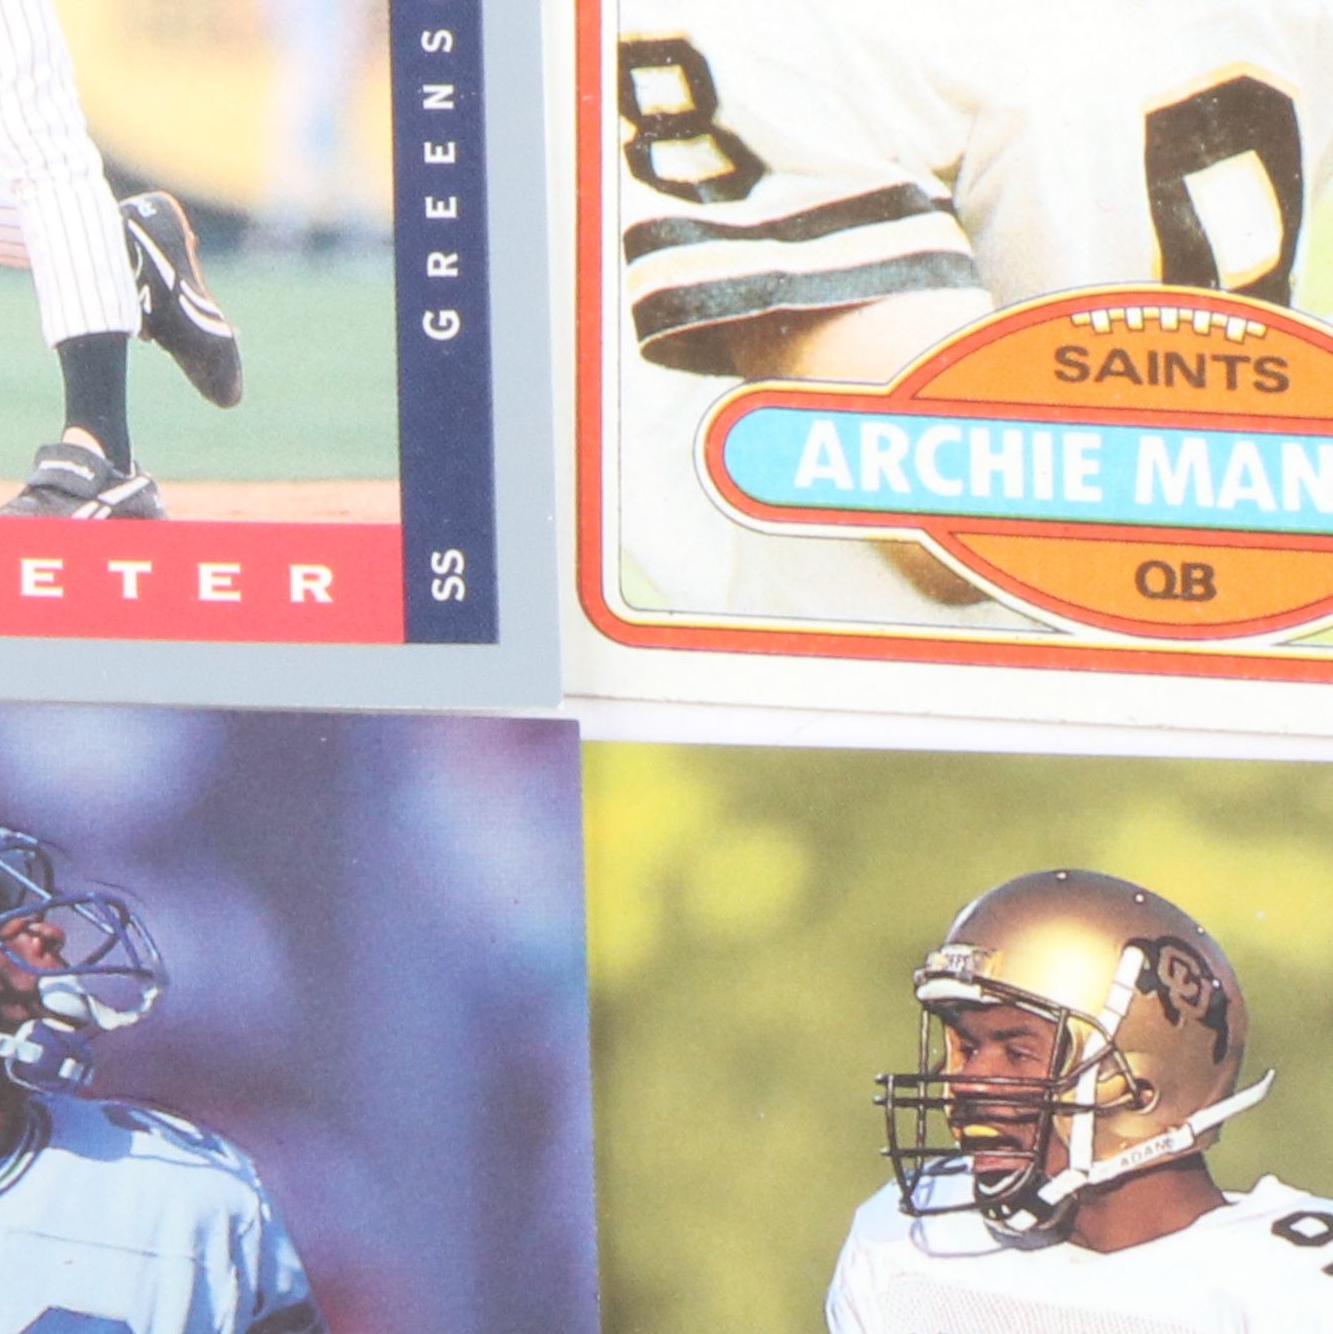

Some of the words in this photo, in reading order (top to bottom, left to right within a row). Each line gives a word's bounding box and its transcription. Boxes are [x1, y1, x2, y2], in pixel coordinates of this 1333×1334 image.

[1054, 345, 1290, 394] SAINTS
[795, 420, 1102, 503] ARCHIE
[1135, 435, 1333, 514] MAN
[432, 548, 465, 601] SS
[1135, 562, 1217, 602] QB
